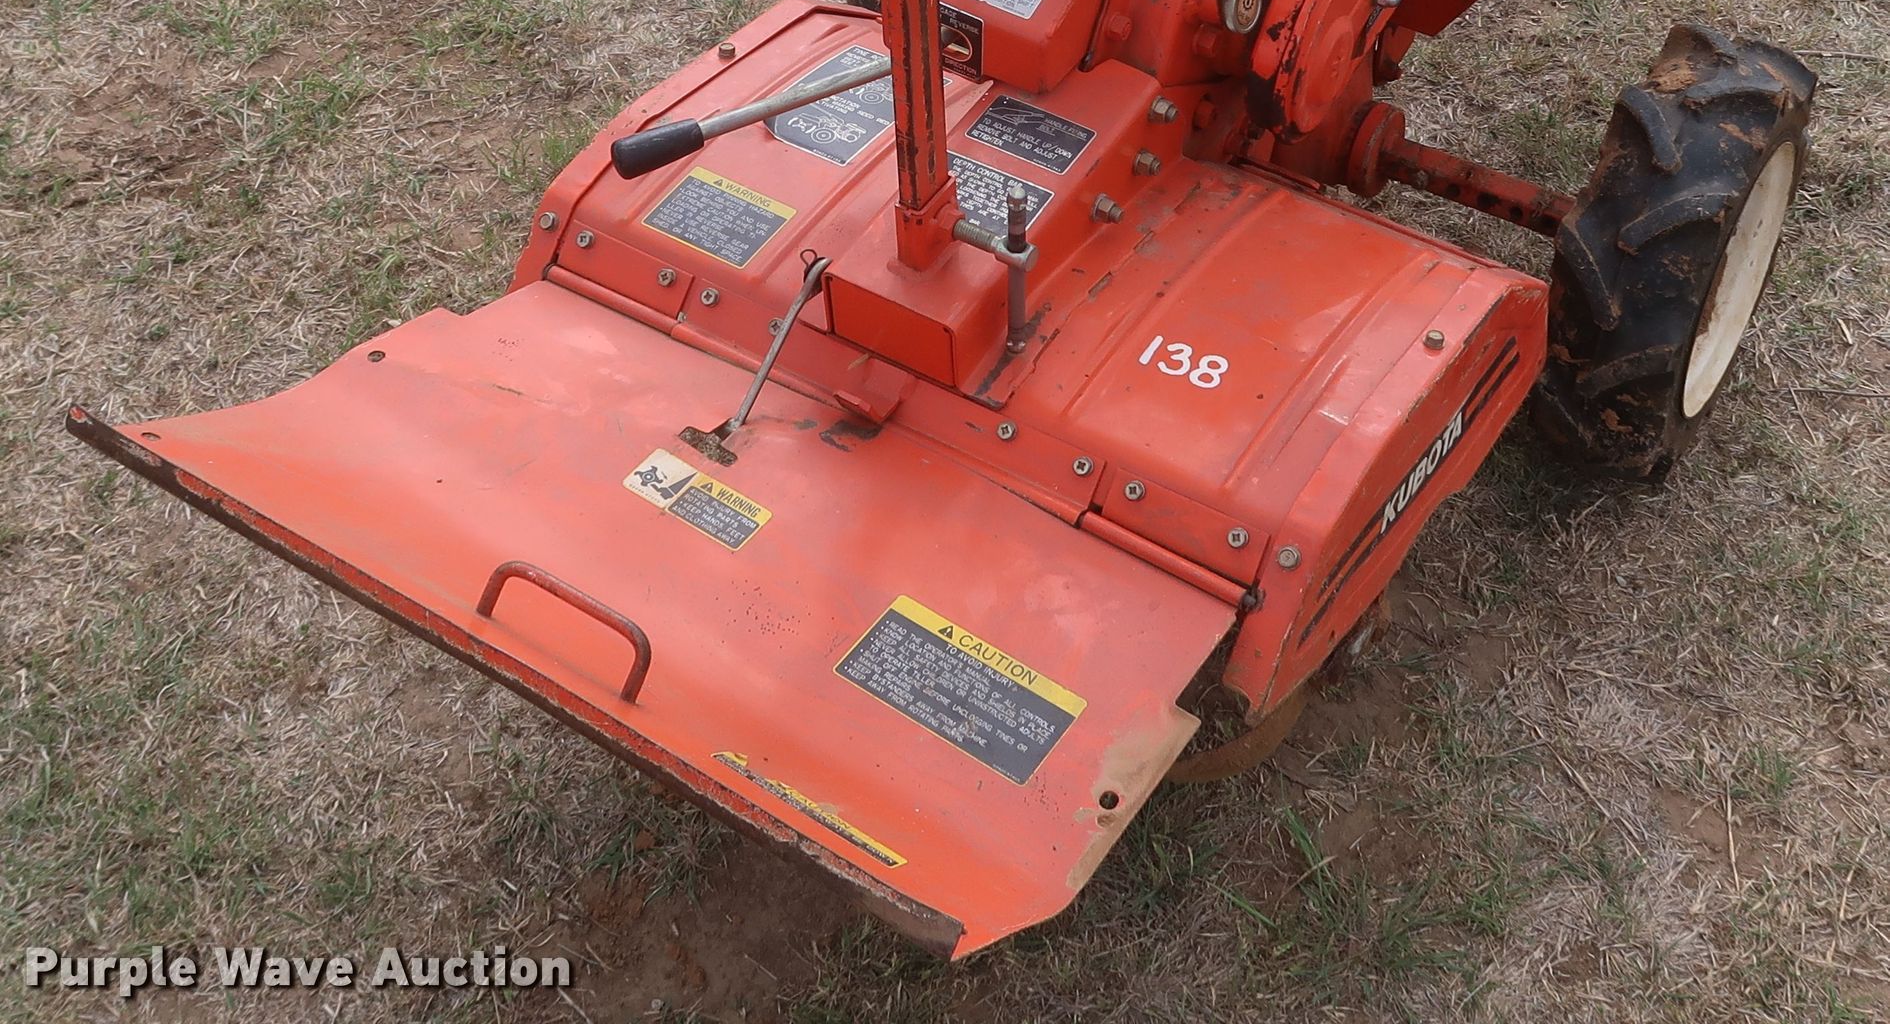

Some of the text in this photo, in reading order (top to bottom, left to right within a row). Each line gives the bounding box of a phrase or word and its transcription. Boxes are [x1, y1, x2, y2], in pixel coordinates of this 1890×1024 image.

[971, 129, 1003, 145] RETIGHTEN
[976, 124, 1000, 136] REMOVE
[1001, 134, 1017, 142] BOLT
[1033, 147, 1057, 159] ADJUST
[992, 122, 1015, 134] ADJUST
[1016, 131, 1040, 144] HANDLE
[1041, 141, 1073, 157] UP/DOWN
[952, 158, 975, 170] DEPTH
[976, 167, 1006, 182] CONTROL
[681, 188, 698, 198] LOOK
[740, 215, 754, 223] AND
[755, 222, 770, 230] USE
[702, 184, 721, 194] AVOID
[748, 204, 774, 218] HAZARD
[706, 207, 734, 221] CAUTION
[724, 183, 772, 206] WARNING
[661, 207, 683, 219] NEVER
[700, 225, 729, 240] REVERSE
[730, 239, 749, 249] GEAR
[699, 240, 717, 250] TIGHT
[716, 240, 742, 254] CLOSED
[1139, 336, 1228, 388] 138
[1382, 412, 1462, 534] KUBOTA
[671, 505, 686, 515] AND
[684, 512, 717, 534] CLOTHING
[682, 501, 702, 515] KEEP
[725, 527, 744, 540] FEET
[683, 493, 739, 528] ROTATING PARTS
[688, 487, 756, 529] AVOID INJURY FROM
[715, 488, 760, 517] WARNING
[857, 656, 882, 673] MAKING
[868, 645, 879, 653] TO
[879, 651, 910, 672] OPERATE
[888, 622, 907, 634] READ
[908, 634, 922, 644] THE
[924, 643, 963, 668] OPERATOR'S
[958, 634, 1036, 684] CAUTION
[878, 633, 896, 646] KEEP
[898, 645, 912, 656] ALL
[913, 654, 939, 672] SAFETY
[942, 671, 970, 690] DEVICES
[971, 689, 986, 700] AND
[987, 698, 1015, 717] SHIELDS
[883, 627, 902, 641] KNOW
[904, 640, 936, 661] LOCATION
[937, 660, 952, 670] AND
[953, 669, 989, 692] FUNCTIONS
[991, 691, 1001, 700] OF
[1003, 699, 1018, 709] ALL
[944, 644, 1013, 688] TO AVOID INJURY
[846, 668, 865, 681] KEEP
[866, 680, 884, 693] AWAY
[886, 692, 907, 706] FROM
[907, 704, 939, 726] ROTATING
[852, 662, 870, 675] KEEP
[872, 674, 914, 701] BYSTANDERS
[916, 700, 934, 714] AWAY
[936, 712, 956, 727] FROM
[862, 650, 1028, 752] SHUT OFF ENGINE BEFORE UNCLOGGING TINES OR
[872, 639, 1045, 744] NEVER ALLOW CHILDREN OR UNINSTRUCTED ADULTS
